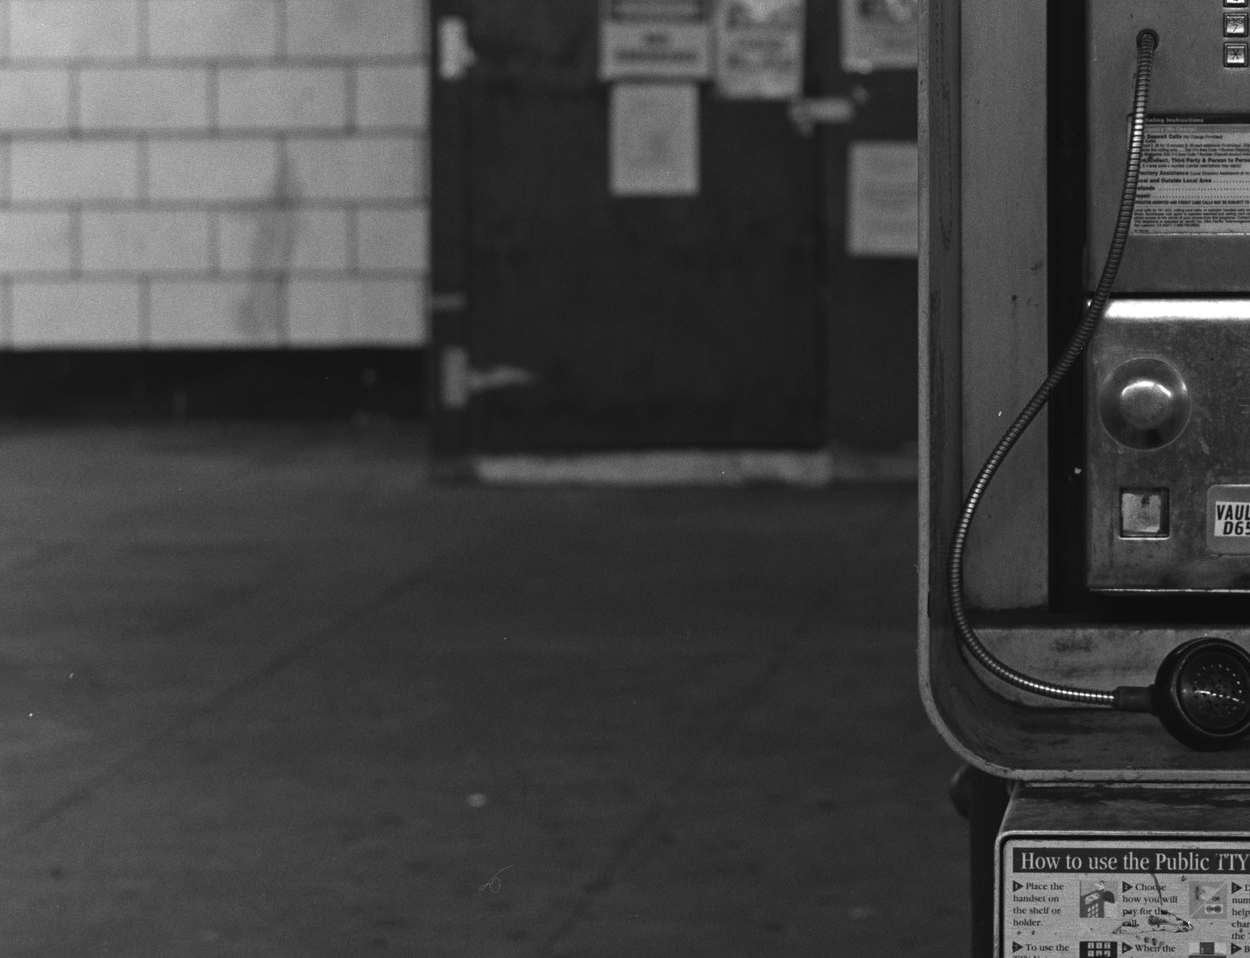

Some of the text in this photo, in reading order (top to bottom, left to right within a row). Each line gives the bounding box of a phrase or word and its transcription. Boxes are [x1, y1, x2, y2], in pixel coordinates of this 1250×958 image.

[1232, 23, 1239, 32] 7
[1020, 851, 1061, 870] How
[1065, 854, 1083, 870] to
[1088, 856, 1118, 870] use
[1123, 851, 1150, 870] the
[1155, 851, 1210, 871] Public
[1026, 882, 1064, 891] Place the
[1135, 883, 1167, 891] Choose
[1013, 894, 1045, 902] handset
[1122, 895, 1178, 905] how you will
[1029, 906, 1049, 915] shelf
[1122, 907, 1152, 917] pay for
[1232, 908, 1250, 918] help
[1013, 918, 1043, 927] holder.
[1231, 932, 1245, 940] the
[1025, 943, 1037, 951] To
[1056, 943, 1070, 951] the
[1135, 944, 1176, 952] When the
